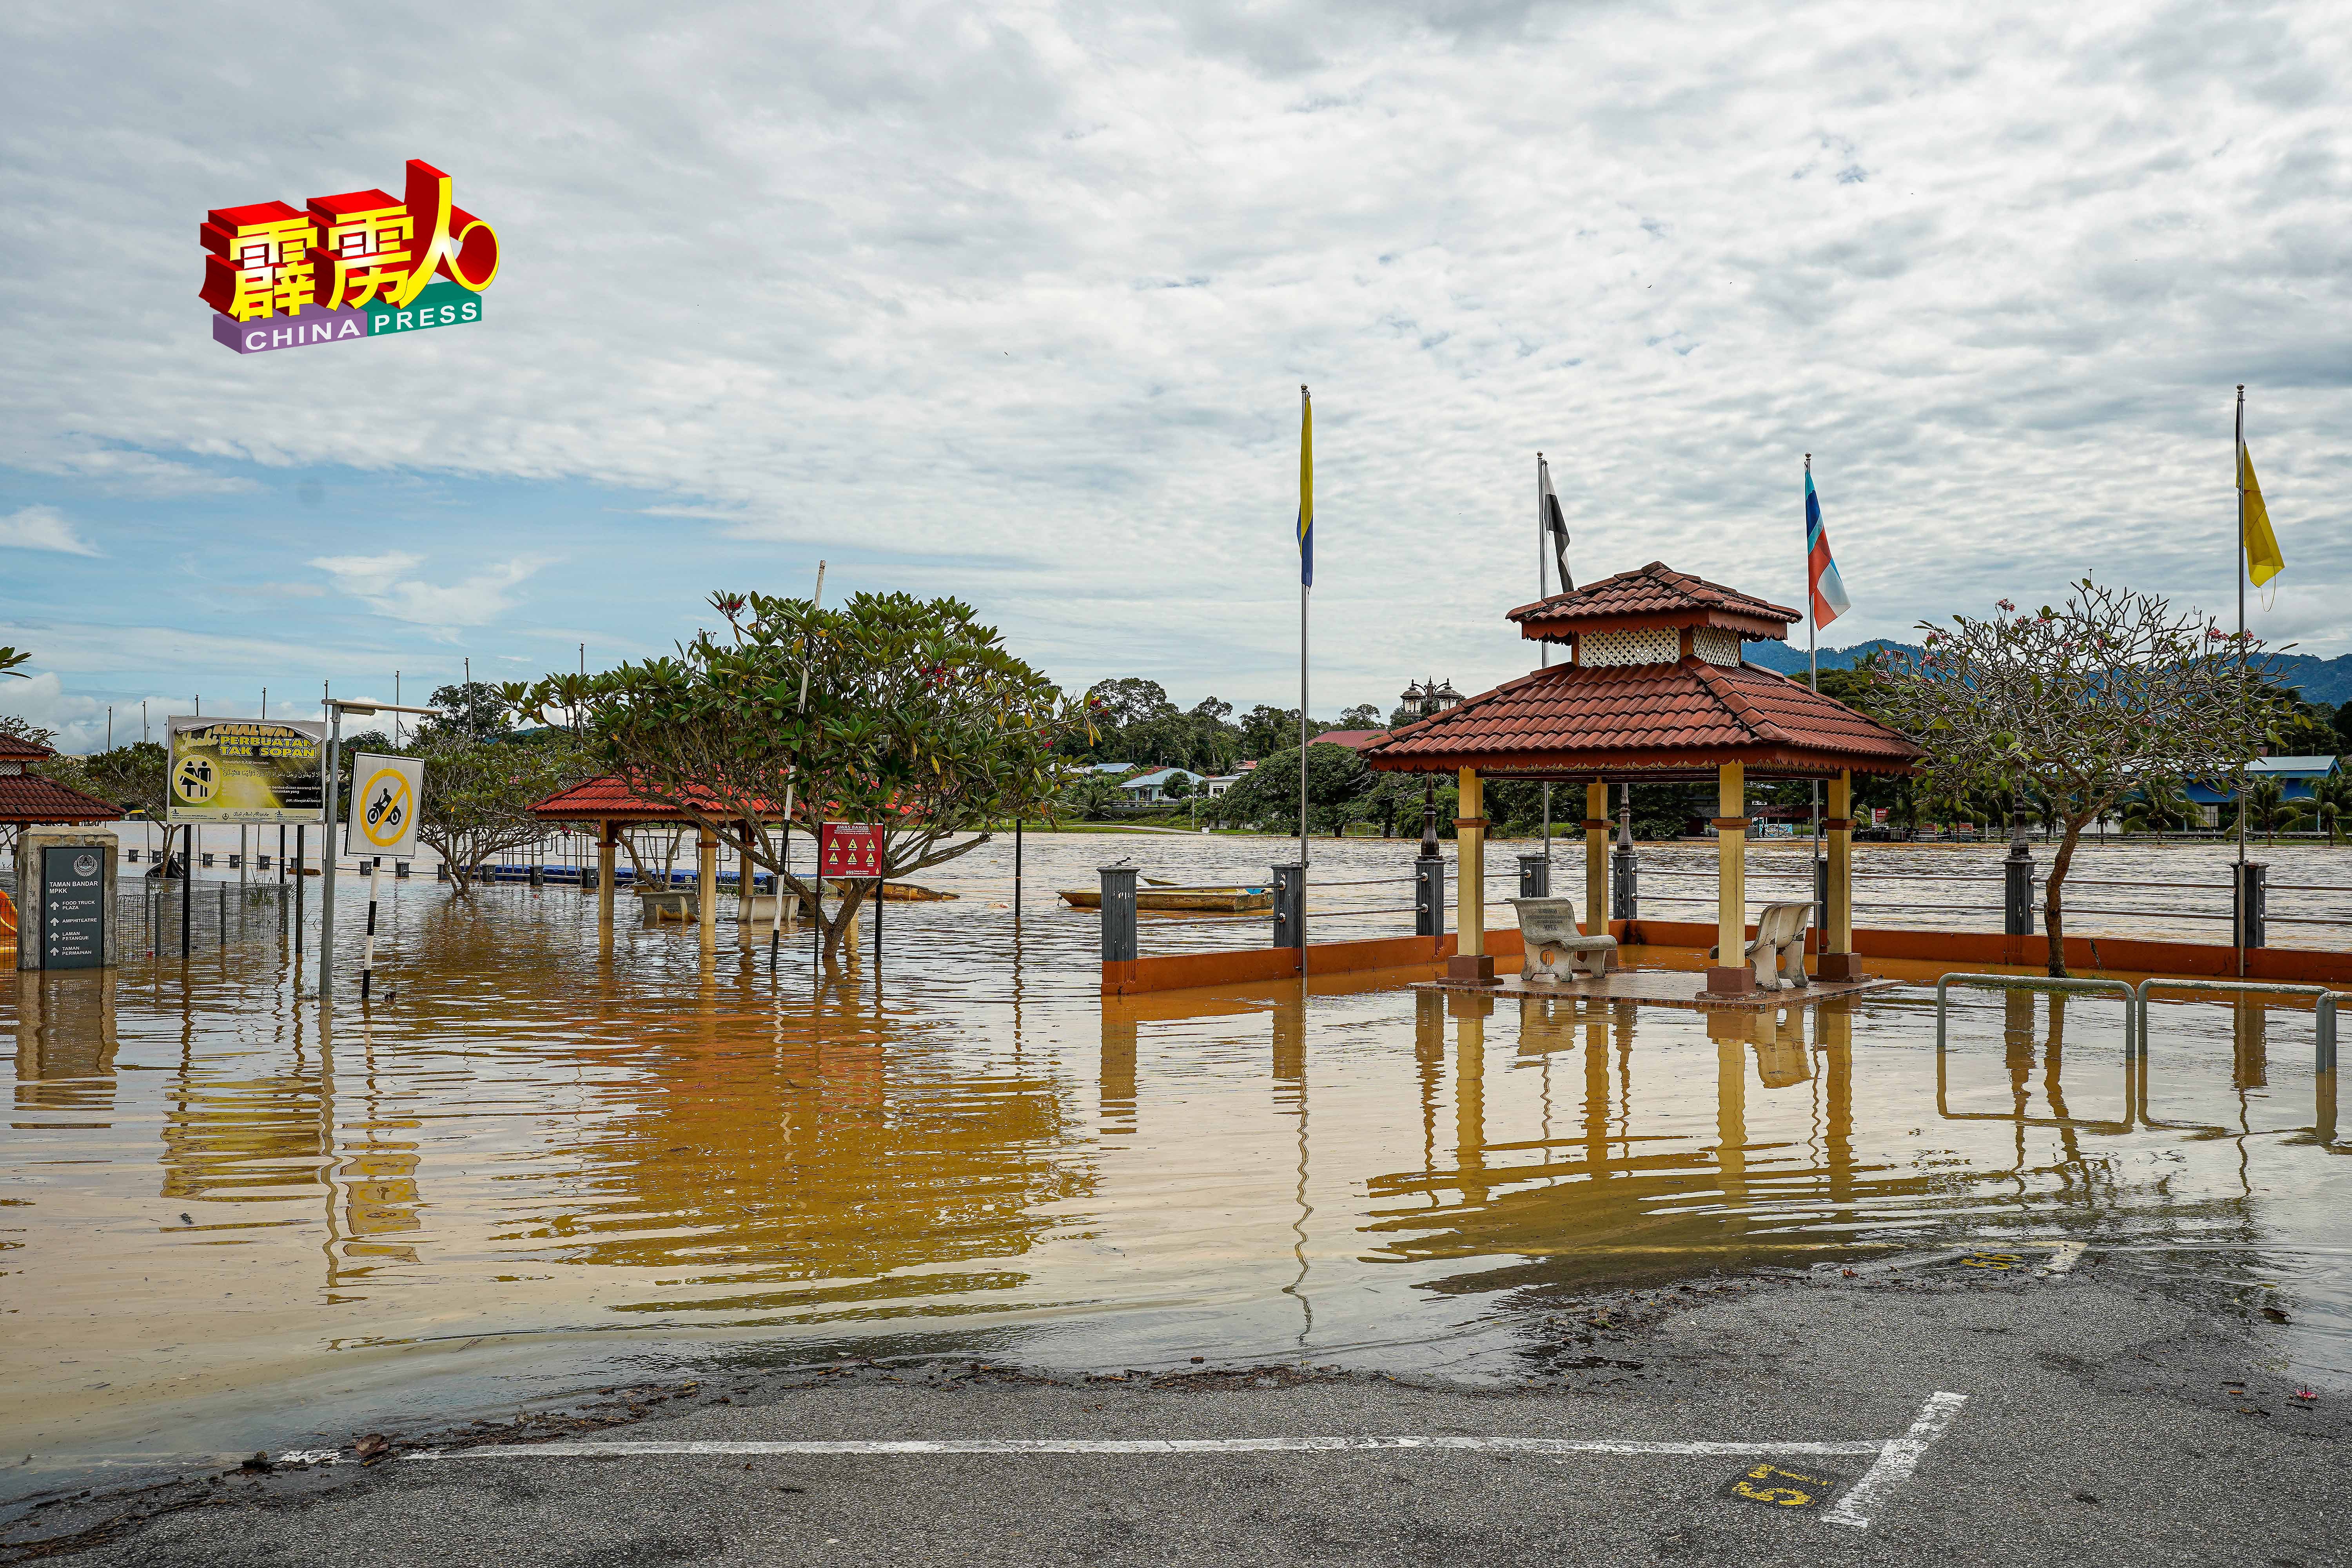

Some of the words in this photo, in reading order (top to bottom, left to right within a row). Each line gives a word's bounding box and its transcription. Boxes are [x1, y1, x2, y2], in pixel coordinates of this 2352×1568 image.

[220, 736, 315, 747] PERBUATAN
[220, 746, 252, 755] TAK
[260, 748, 315, 757] SOPAN
